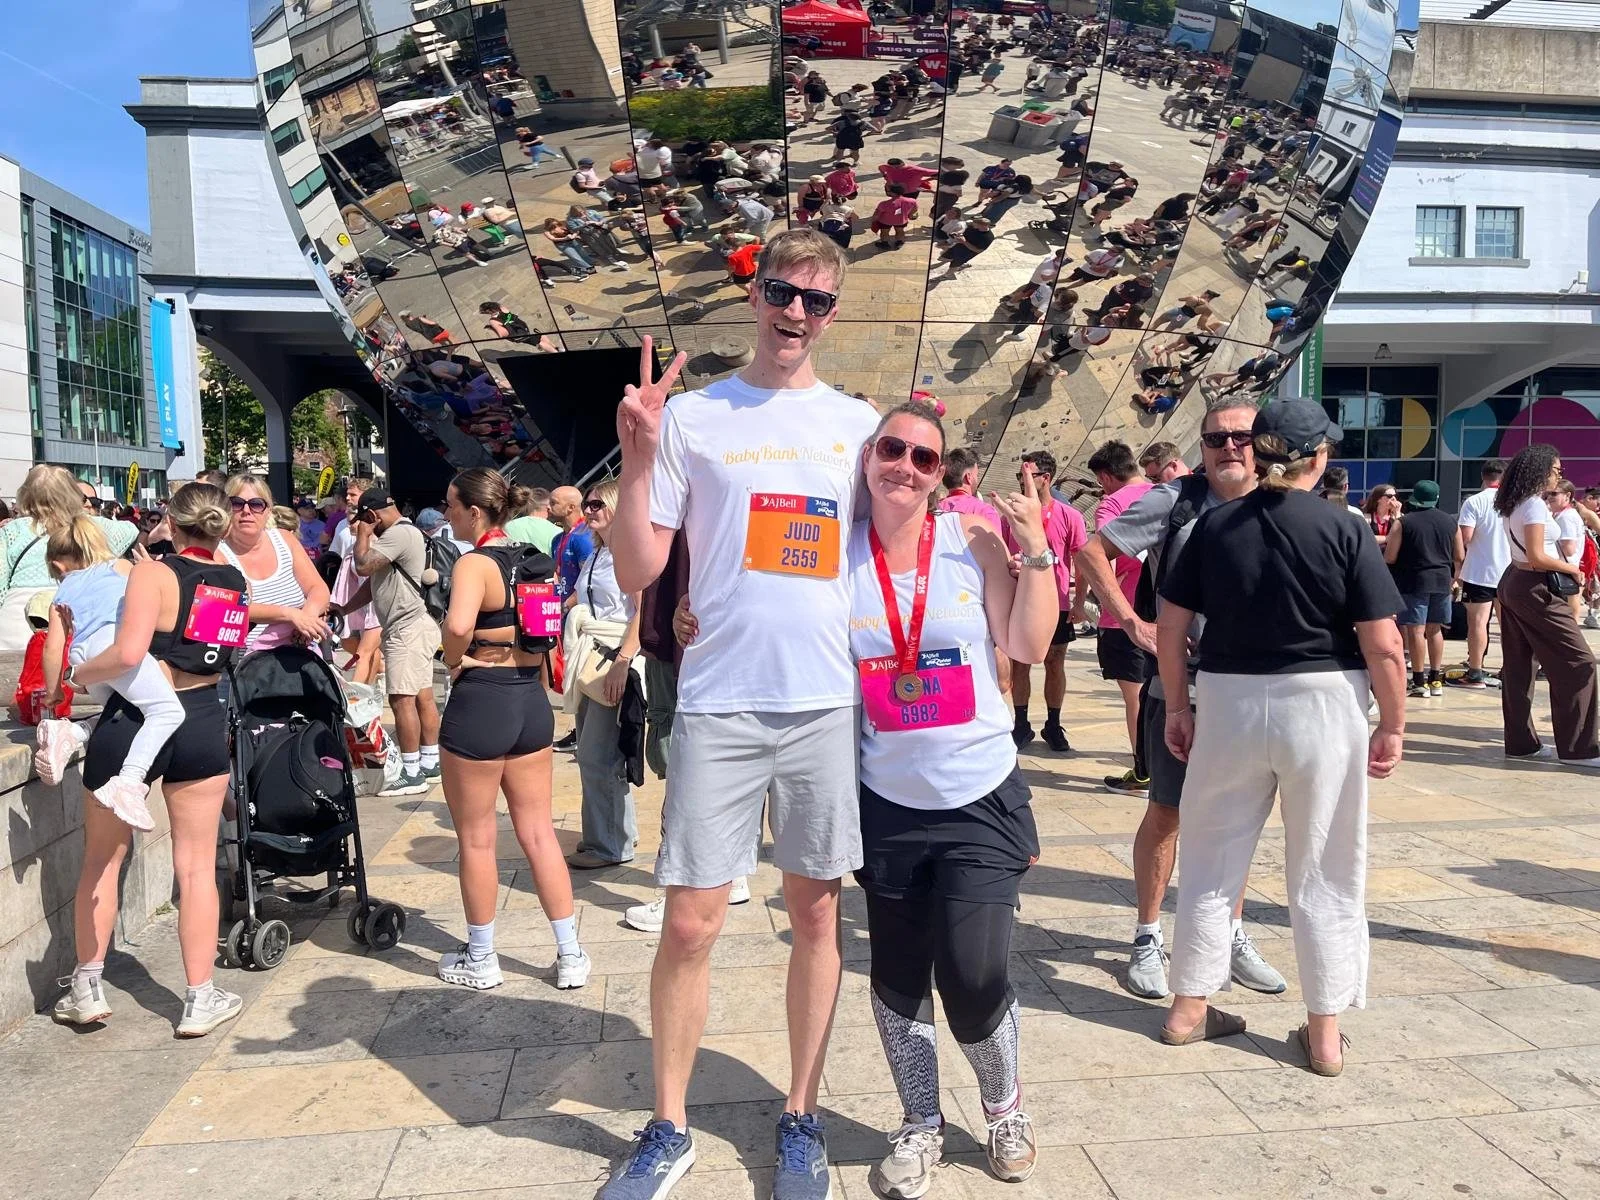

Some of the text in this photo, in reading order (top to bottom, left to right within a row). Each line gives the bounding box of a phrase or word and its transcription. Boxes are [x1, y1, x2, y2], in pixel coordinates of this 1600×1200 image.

[163, 384, 172, 422] PLAY
[724, 450, 759, 464] Baby
[761, 445, 798, 460] Bank
[768, 498, 797, 509] AJBell
[783, 521, 821, 542] JUDD
[781, 547, 818, 569] 2559
[223, 609, 245, 625] LEAH
[217, 627, 240, 643] 9802
[877, 659, 899, 671] AJBe
[901, 703, 939, 724] 6982
